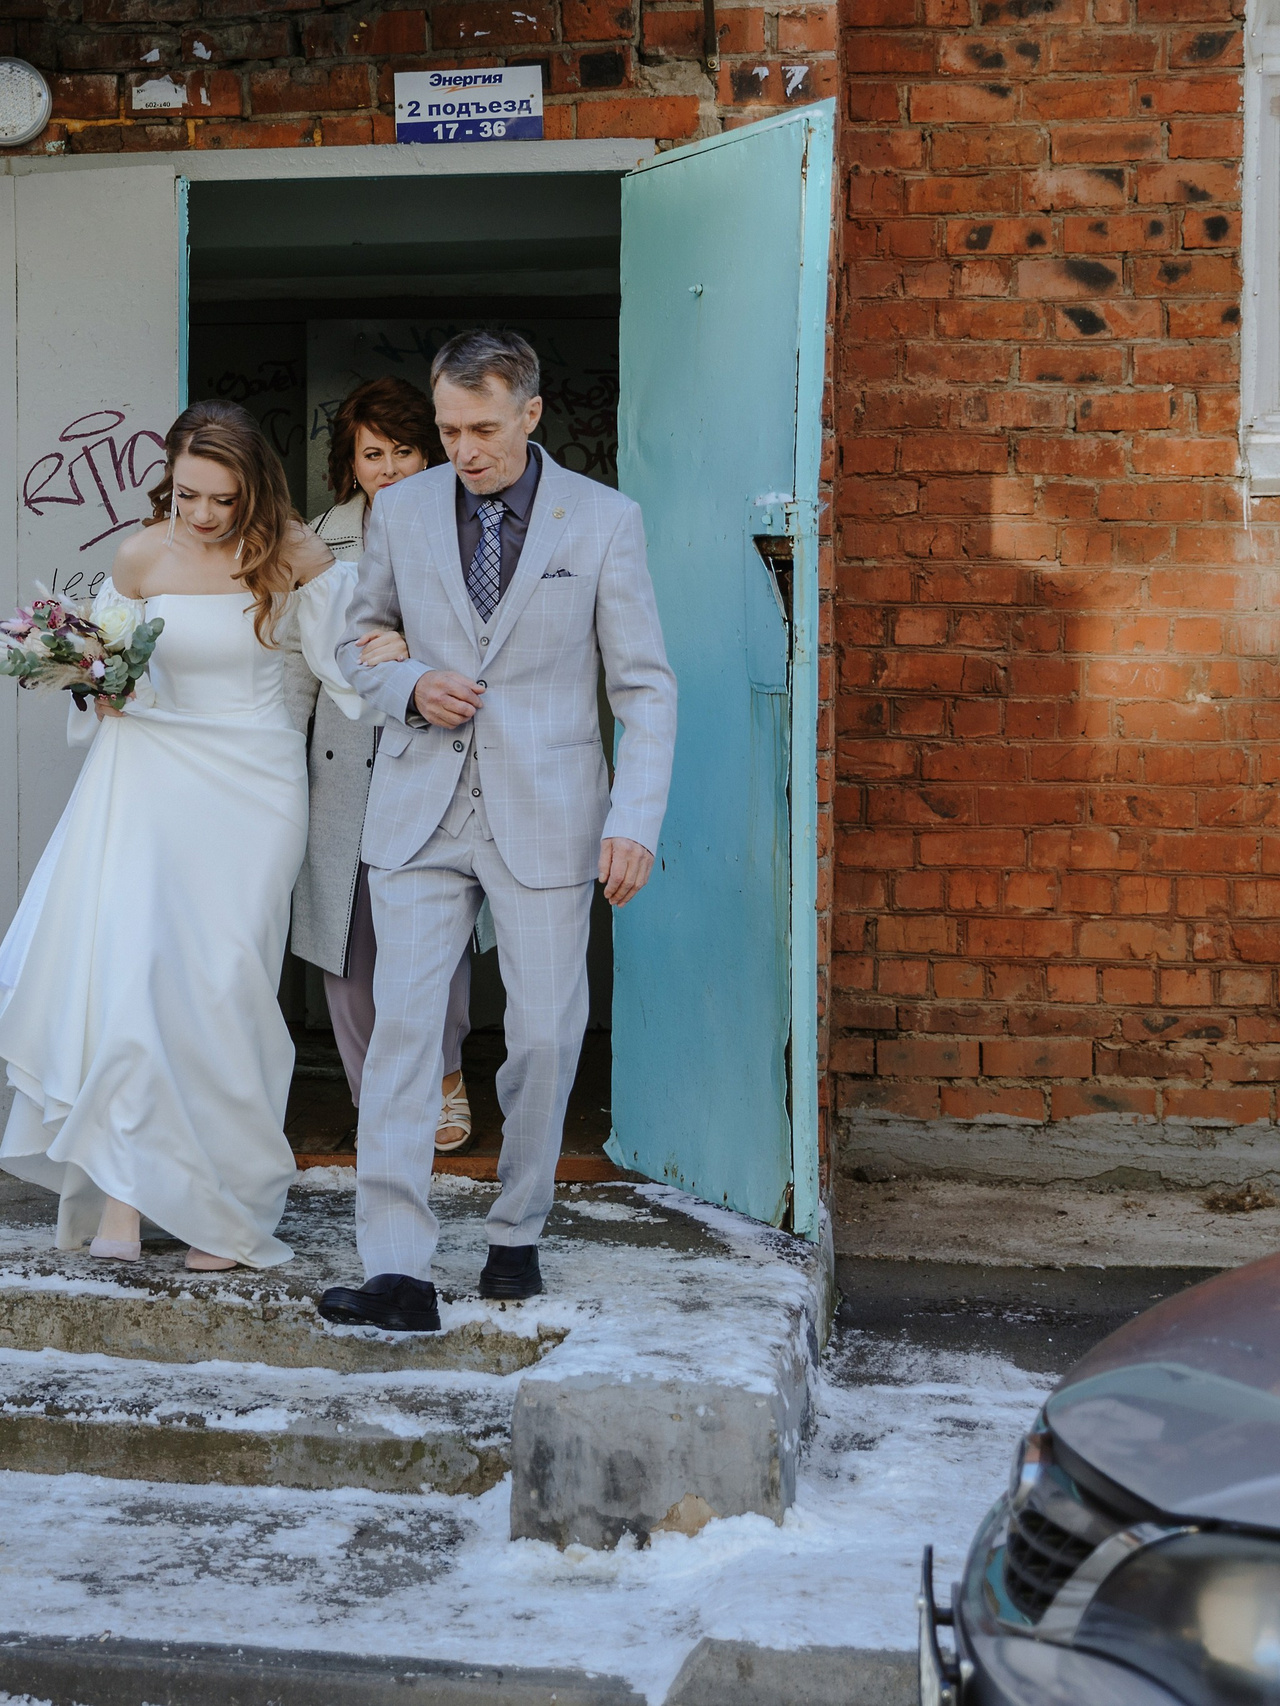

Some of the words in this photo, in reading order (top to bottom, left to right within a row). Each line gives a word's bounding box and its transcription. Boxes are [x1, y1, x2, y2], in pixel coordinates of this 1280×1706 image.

[429, 73, 503, 87] Энергия
[407, 100, 421, 117] 2
[428, 99, 532, 118] подъезд
[433, 123, 459, 140] 17
[479, 121, 506, 137] 36
